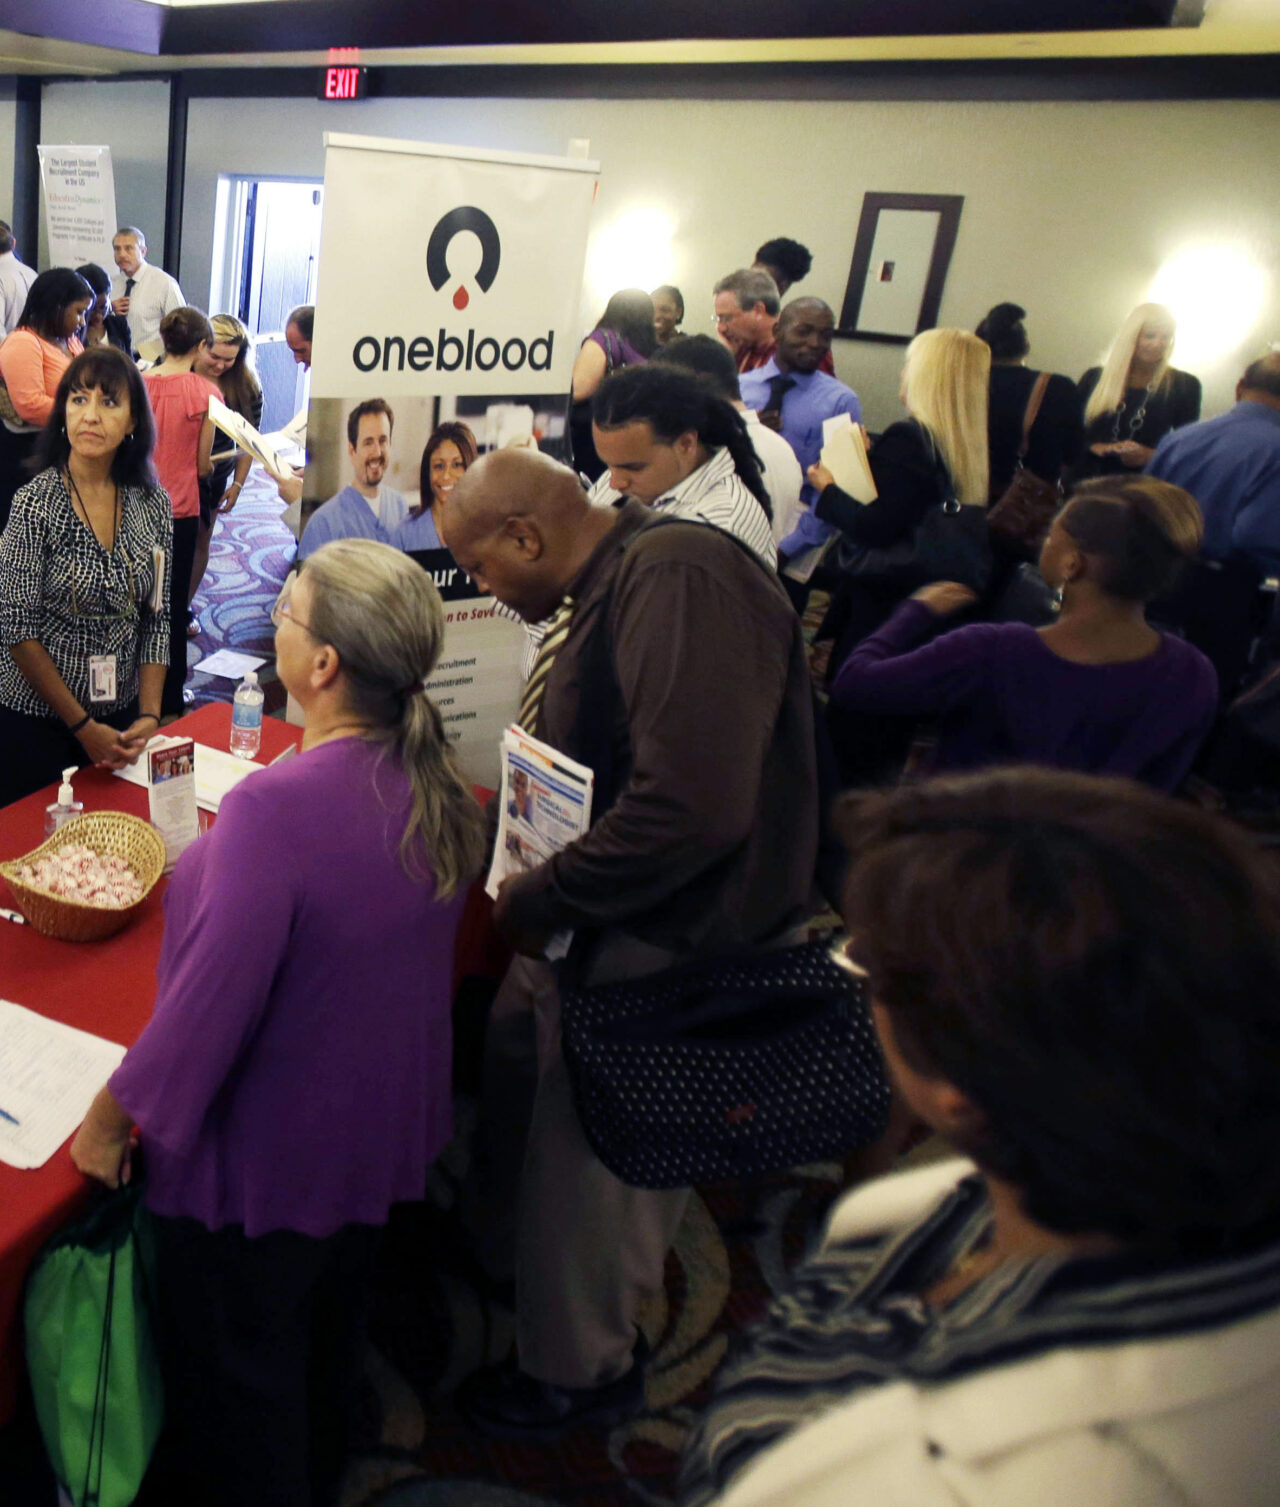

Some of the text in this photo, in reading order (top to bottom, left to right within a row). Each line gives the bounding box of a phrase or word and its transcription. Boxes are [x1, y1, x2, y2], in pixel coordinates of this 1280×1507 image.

[325, 68, 360, 98] EXIT
[353, 328, 554, 372] oneblood
[456, 610, 468, 622] to
[435, 657, 477, 670] ecruitment
[424, 676, 474, 691] dministration
